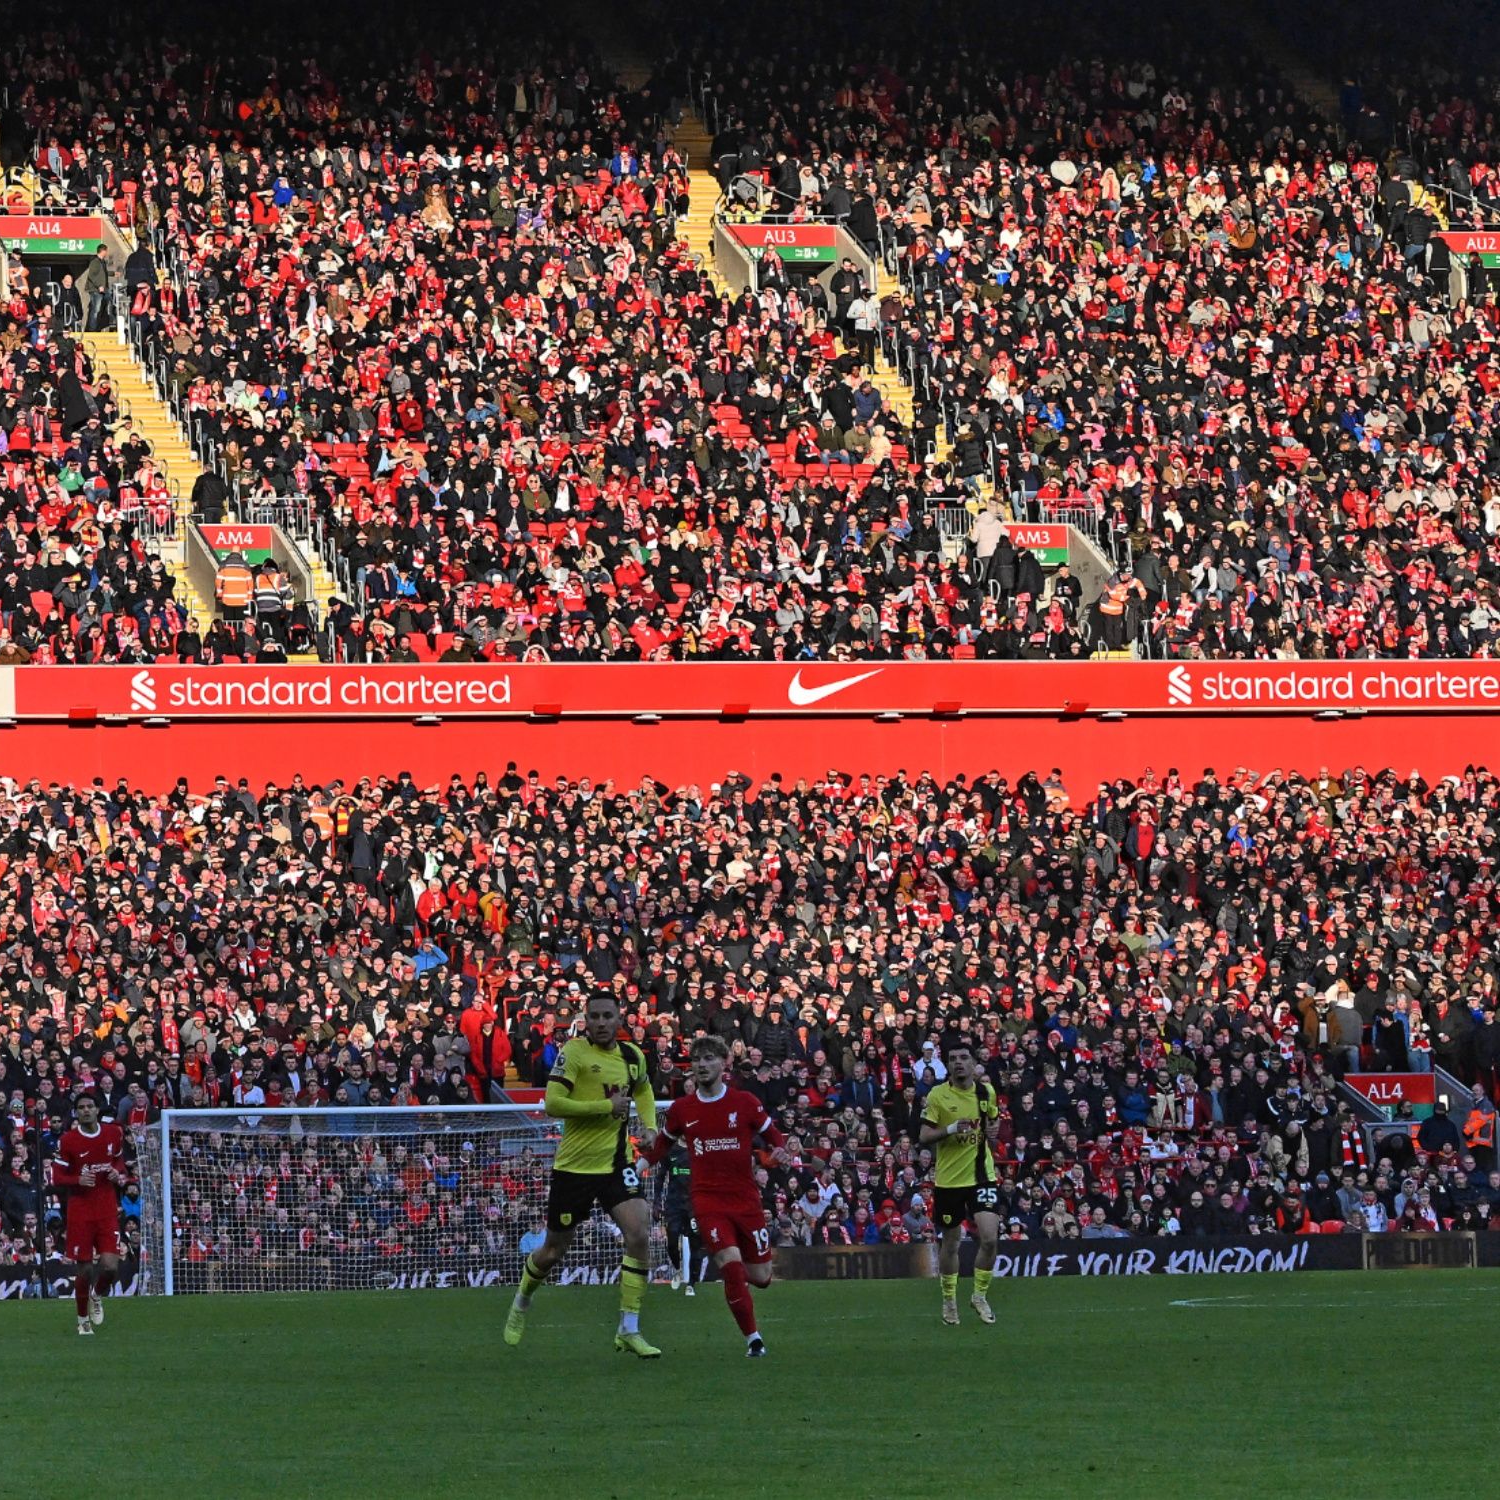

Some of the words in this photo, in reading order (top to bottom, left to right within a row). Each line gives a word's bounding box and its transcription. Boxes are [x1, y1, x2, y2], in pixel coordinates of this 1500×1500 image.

[27, 221, 62, 235] AU4
[764, 230, 796, 244] AU3
[1466, 237, 1497, 250] AU2
[215, 531, 253, 545] AM4
[1015, 530, 1051, 545] AM3
[169, 676, 331, 706] standard
[340, 674, 511, 705] chartered
[1202, 671, 1352, 700] standard
[1361, 671, 1500, 699] chartere
[1367, 1082, 1404, 1099] AL4
[622, 1167, 639, 1187] 8
[976, 1188, 998, 1203] 25
[753, 1227, 769, 1249] 19
[1077, 1248, 1156, 1276] YOUR
[1162, 1241, 1308, 1275] KINGDOM!
